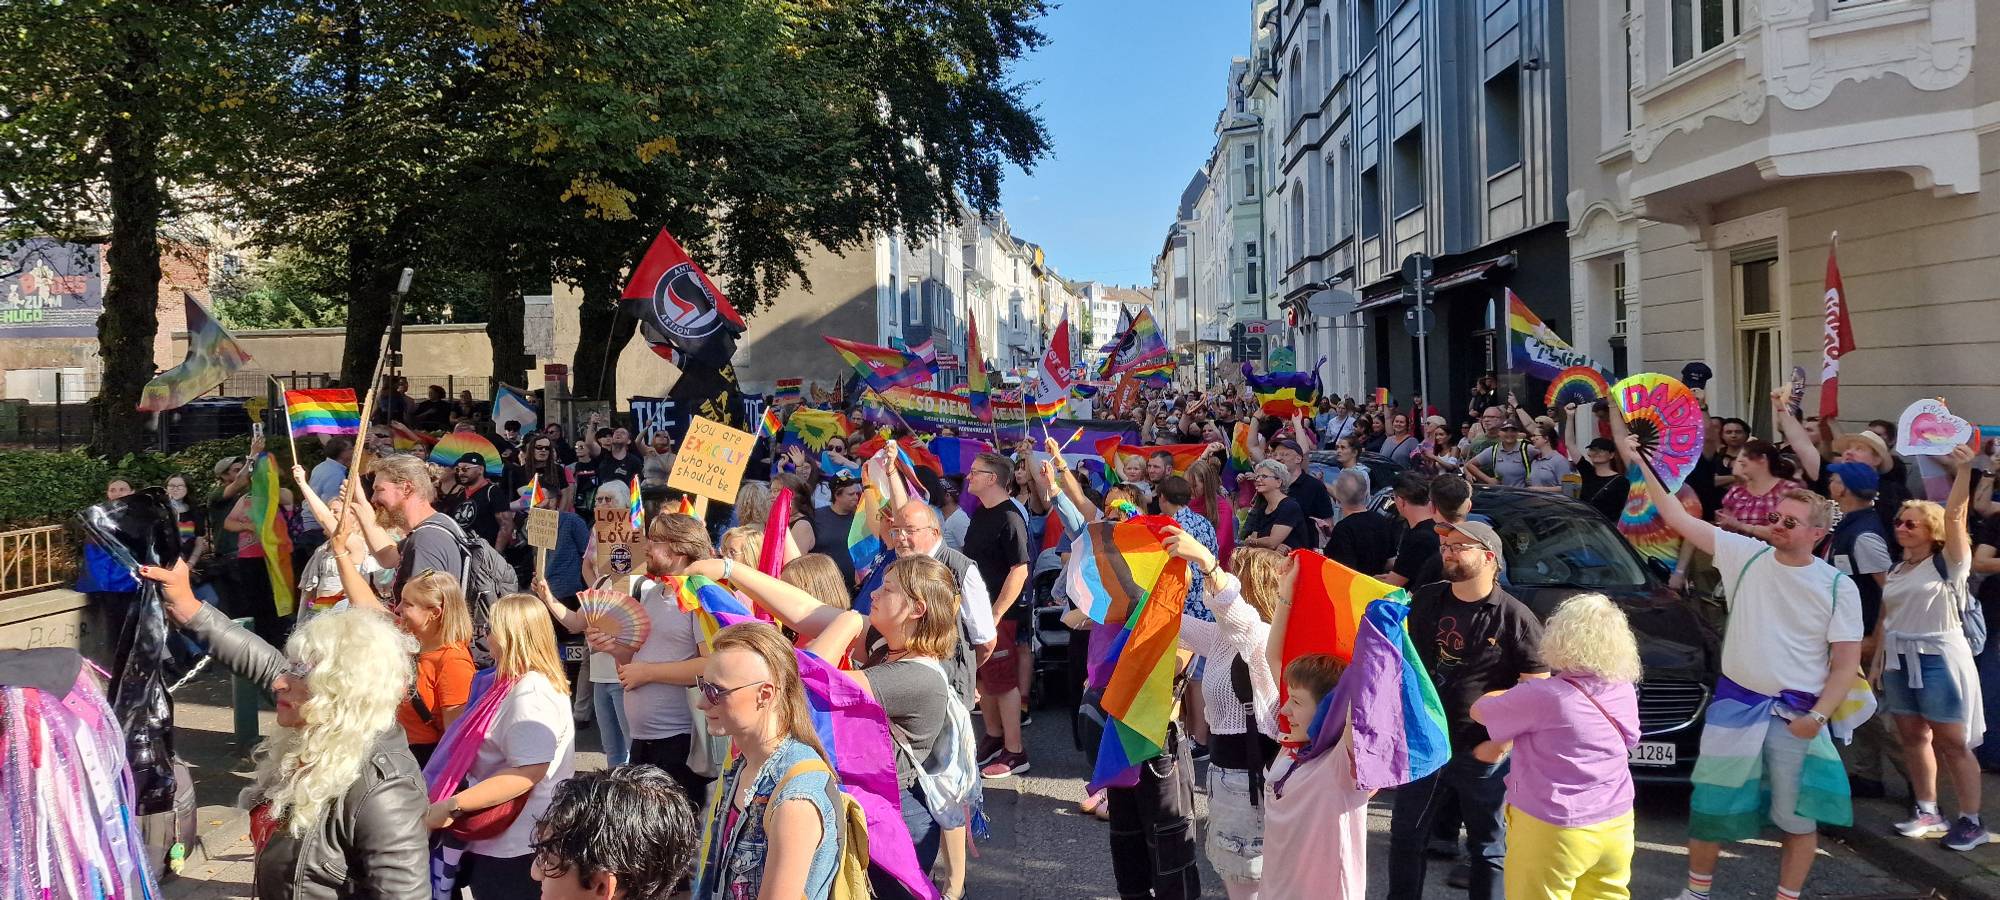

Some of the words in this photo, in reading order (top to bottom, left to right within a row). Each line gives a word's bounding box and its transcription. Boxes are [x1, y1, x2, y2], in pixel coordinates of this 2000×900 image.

[660, 314, 690, 335] AKTION
[909, 394, 935, 413] CSD
[631, 402, 676, 445] THE
[694, 422, 716, 437] you
[722, 431, 742, 445] are
[1622, 383, 1698, 478] DADDY
[685, 435, 745, 466] EXACTLY
[681, 455, 703, 468] who
[706, 462, 727, 476] you
[676, 466, 714, 487] should
[717, 479, 729, 491] be
[597, 510, 633, 522] LOV
[614, 522, 623, 531] IS
[597, 531, 640, 544] LOVE
[567, 647, 582, 659] RS
[1637, 745, 1673, 760] 1284
